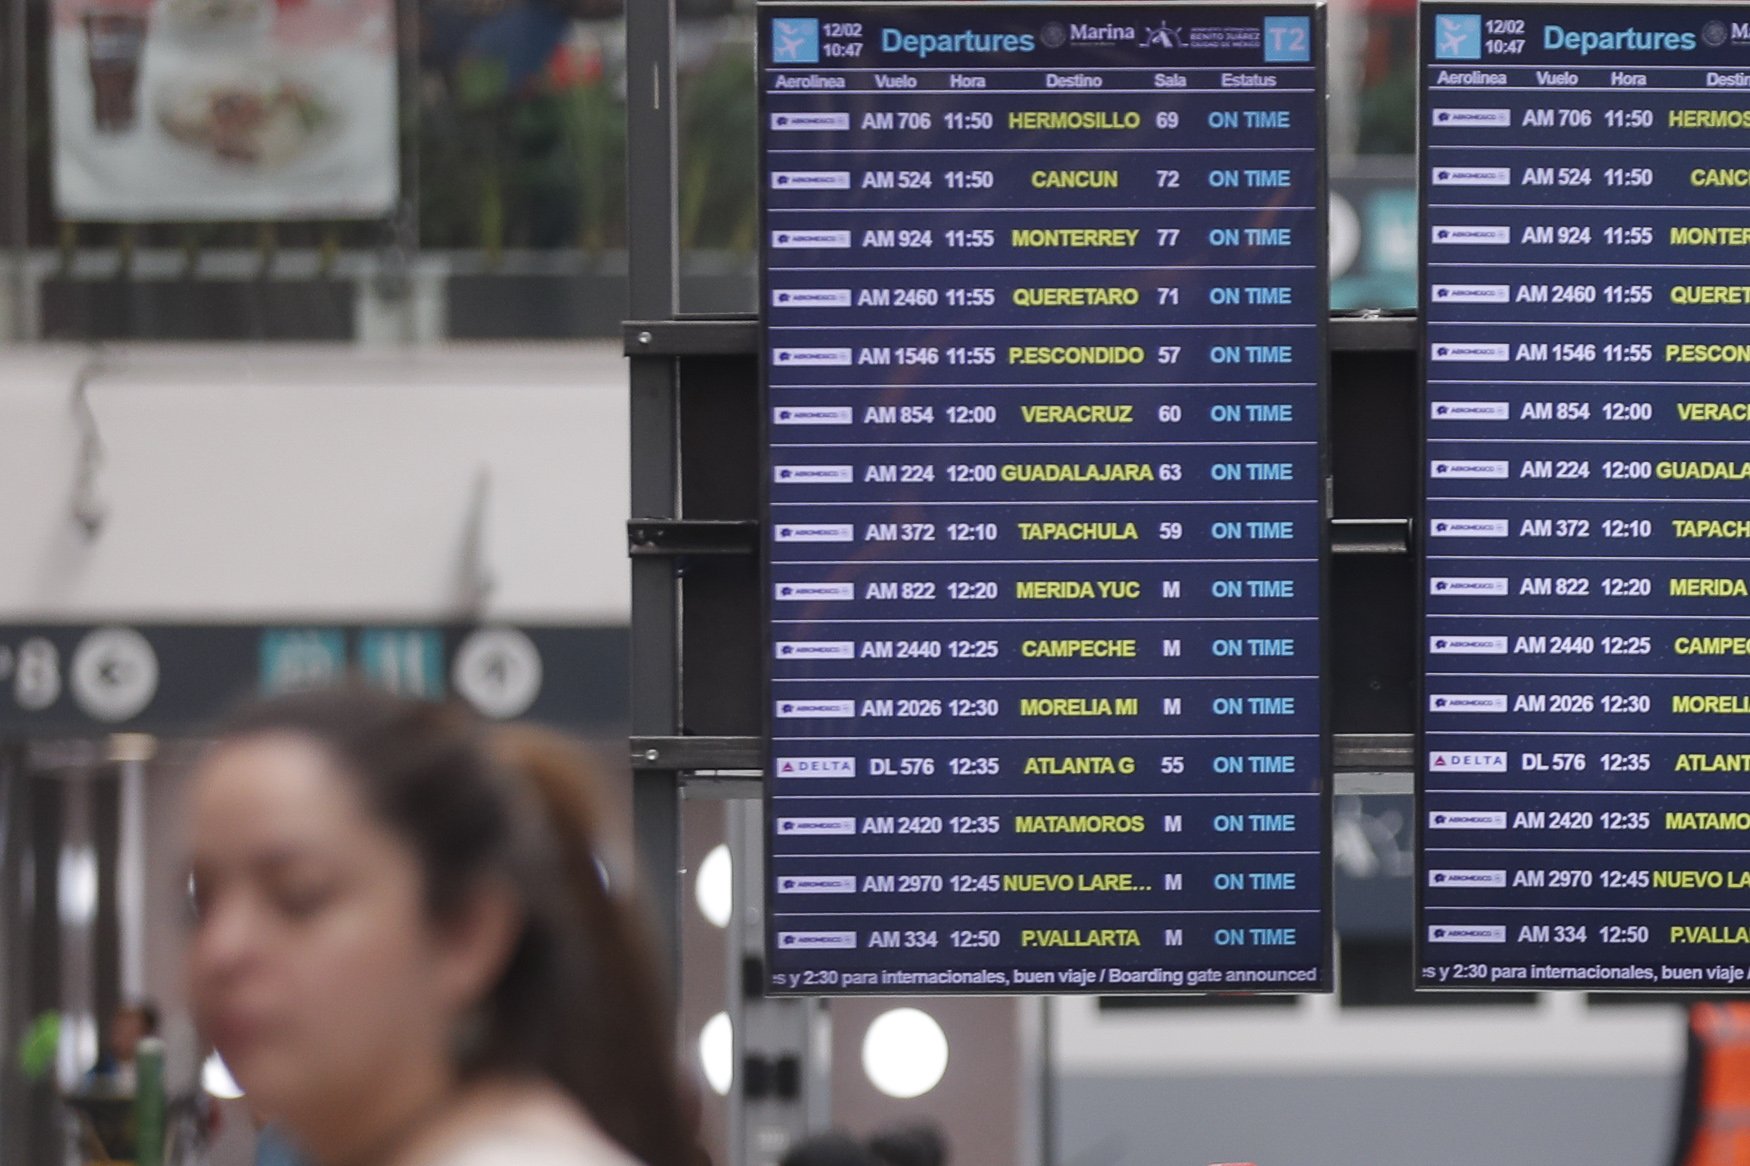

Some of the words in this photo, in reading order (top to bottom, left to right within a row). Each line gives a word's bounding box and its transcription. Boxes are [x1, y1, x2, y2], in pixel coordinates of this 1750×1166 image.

[822, 22, 863, 37] 12/02
[1069, 23, 1136, 40] Marina
[1485, 19, 1526, 34] 12/02
[881, 27, 1036, 59] Departures
[1269, 27, 1306, 52] T2
[1485, 39, 1526, 54] 10:47
[1543, 25, 1697, 56] Departures
[822, 43, 864, 58] 10:47
[1535, 70, 1579, 86] Vuelo
[1610, 71, 1647, 87] Hora
[860, 111, 894, 130] AM
[896, 111, 932, 130] 706
[943, 111, 993, 130] 11:50
[1008, 111, 1140, 129] HERMOSILLO
[1154, 110, 1179, 129] 69
[1207, 110, 1238, 128] ON
[1242, 110, 1290, 128] TIME
[1520, 167, 1554, 185] AM
[1557, 167, 1592, 186] 524
[1603, 167, 1653, 186] 11:50
[856, 288, 890, 306] AM
[892, 288, 939, 306] 2460
[944, 287, 995, 306] 11:55
[1012, 287, 1139, 306] QUERETARO
[1156, 287, 1179, 305] 71
[1208, 287, 1240, 305] ON
[1243, 286, 1292, 304] TIME
[1514, 342, 1548, 361] AM
[1551, 343, 1596, 362] 1546
[1602, 343, 1652, 362] 11:55
[863, 464, 897, 482] AM
[899, 464, 935, 482] 224
[945, 464, 997, 482] 12:00
[1000, 463, 1154, 481] GUADALAJARA
[1158, 463, 1182, 481] 63
[1210, 463, 1241, 480] ON
[1245, 462, 1293, 481] TIME
[1518, 518, 1552, 537] AM
[1555, 518, 1590, 537] 372
[1600, 519, 1652, 538] 12:10
[859, 640, 893, 658] AM
[895, 640, 941, 658] 2440
[947, 639, 999, 658] 12:25
[1021, 639, 1136, 657] CAMPECHE
[1162, 638, 1181, 657] M
[1211, 638, 1243, 656] ON
[1246, 638, 1294, 656] TIME
[1512, 694, 1546, 712] AM
[1548, 694, 1594, 713] 2026
[1599, 694, 1650, 713] 12:30
[797, 761, 851, 771] DELTA
[1451, 755, 1503, 766] DELTA
[860, 816, 894, 834] AM
[896, 816, 943, 834] 2420
[948, 815, 1000, 833] 12:35
[1014, 815, 1145, 833] MATAMOROS
[1163, 814, 1182, 832] M
[1212, 814, 1244, 832] ON
[1247, 813, 1296, 832] TIME
[1511, 869, 1545, 887] AM
[1547, 869, 1593, 888] 2970
[1598, 870, 1650, 888] 12:45
[1652, 870, 1723, 888] NUEVO
[1438, 966, 1450, 981] y
[1452, 964, 1488, 978] 2:30
[1491, 966, 1527, 982] para
[1531, 964, 1659, 982] internacionales,
[1661, 965, 1702, 980] buen
[1706, 965, 1745, 983] viaje
